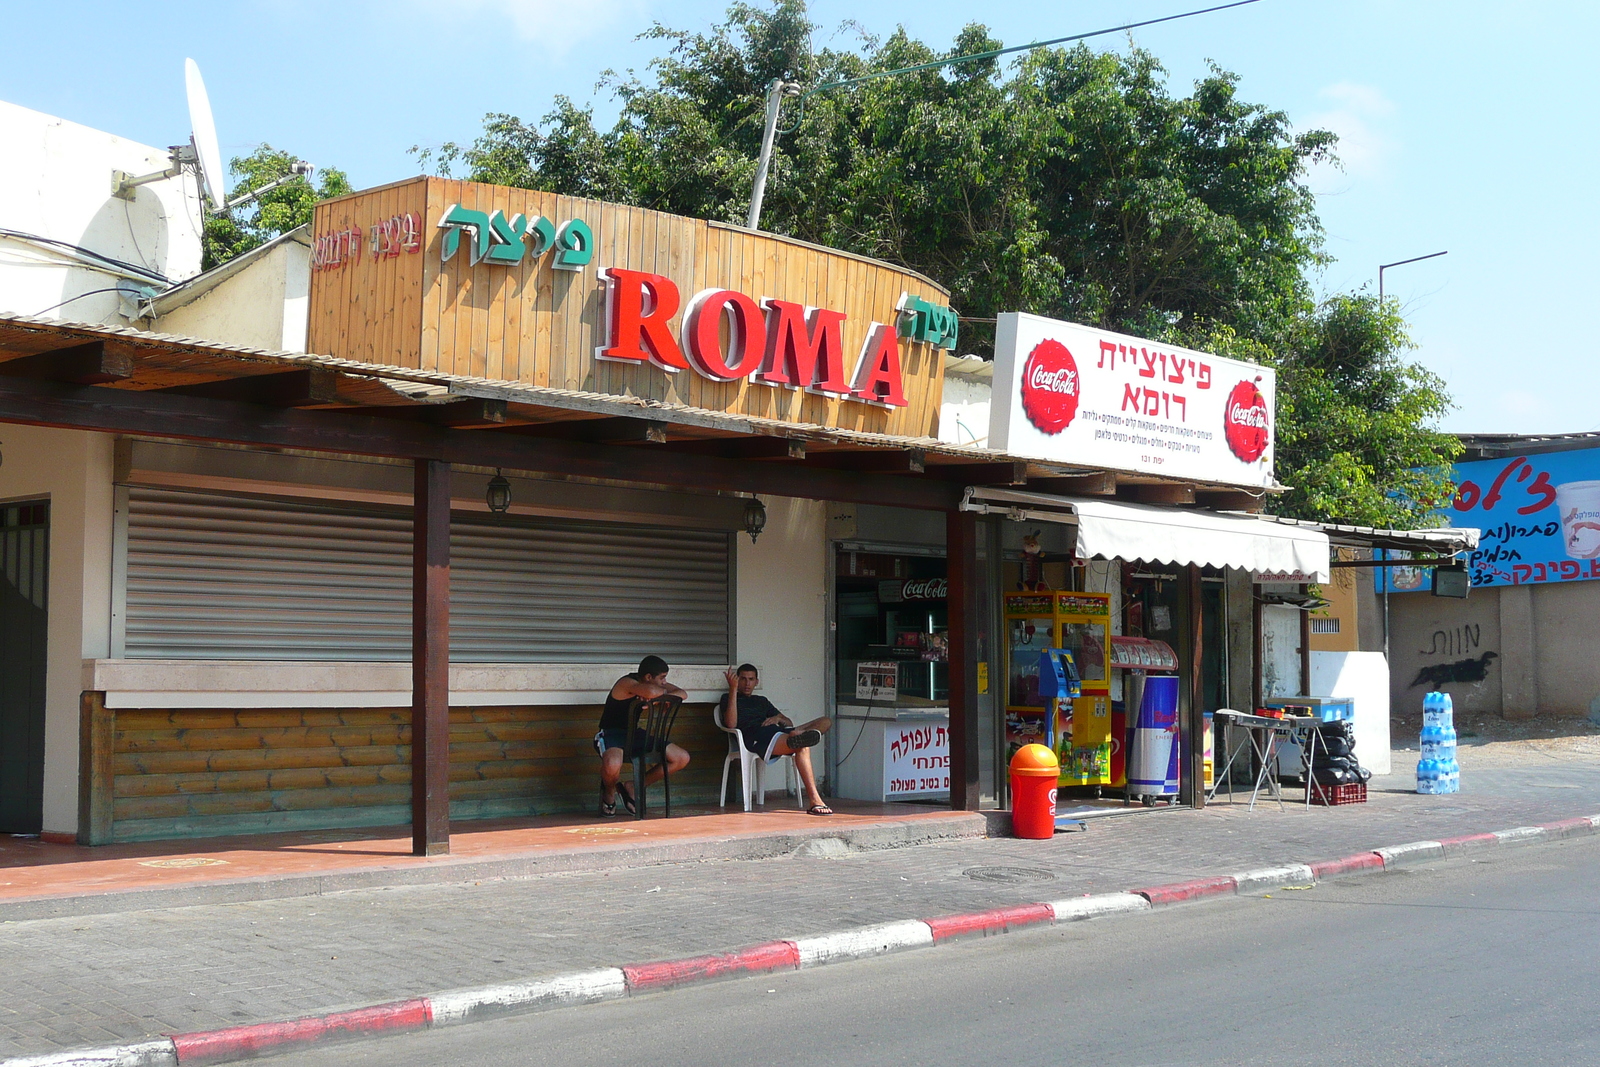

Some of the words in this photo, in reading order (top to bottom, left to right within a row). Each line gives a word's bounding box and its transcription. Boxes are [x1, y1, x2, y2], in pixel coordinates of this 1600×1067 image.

[438, 203, 593, 272] פיצה
[595, 267, 908, 410] ROMA
[1097, 339, 1212, 389] פיצוציית
[1121, 383, 1187, 422] רומא
[1125, 417, 1137, 429] קלים
[1141, 454, 1151, 463] 131
[1479, 521, 1560, 544] פתרונות
[1469, 545, 1523, 569] חכמים
[1420, 623, 1481, 656] מוות
[890, 725, 932, 763] עפולה
[920, 777, 940, 790] בטיב
